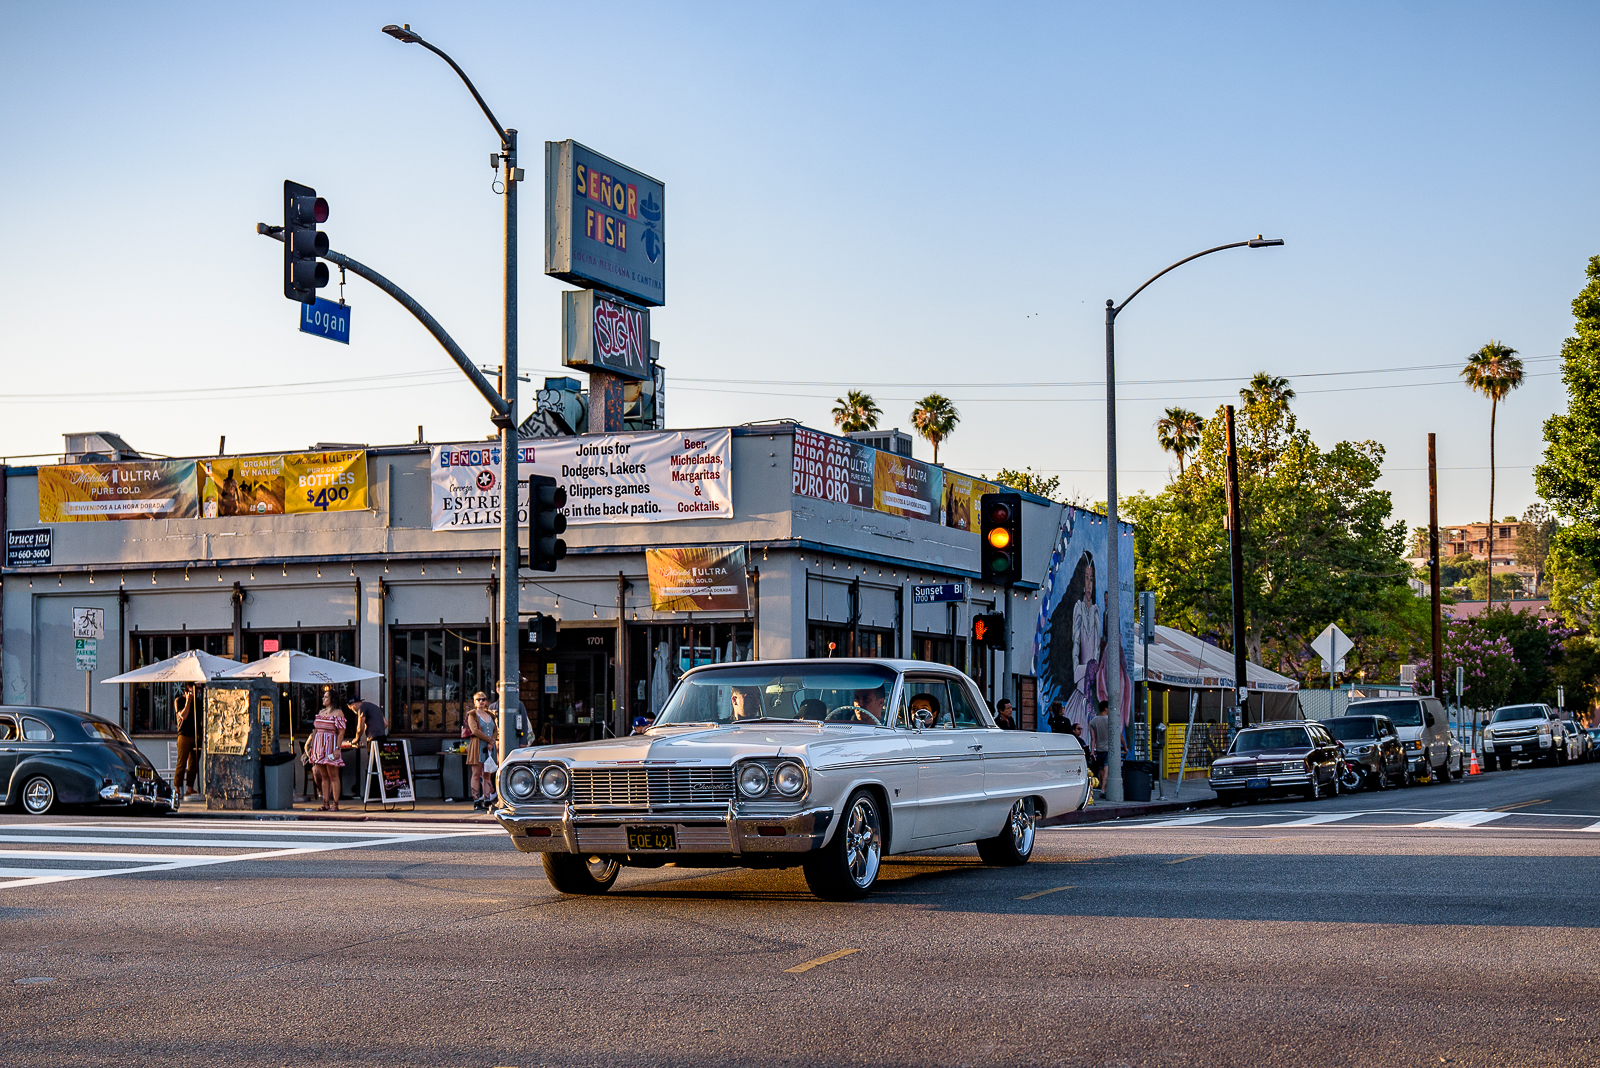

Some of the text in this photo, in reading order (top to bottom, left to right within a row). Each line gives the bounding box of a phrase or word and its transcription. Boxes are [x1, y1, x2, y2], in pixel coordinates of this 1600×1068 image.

[577, 164, 636, 216] SEÑOR
[588, 210, 626, 248] FISH
[573, 250, 596, 266] COCINA
[600, 260, 630, 278] MEXICANA
[637, 274, 662, 290] CANTINA
[306, 304, 344, 334] Logan
[595, 300, 644, 369] SIGN
[576, 442, 630, 456] Join us for
[684, 439, 707, 450] Beer,
[329, 454, 360, 462] ULTRA
[441, 450, 490, 466] SEÑOR
[671, 454, 722, 466] Micheladas,
[562, 462, 646, 479] Dodgers, Lakers
[850, 458, 872, 474] ULTRA
[69, 468, 161, 484] Michelob ULTRA
[299, 472, 355, 487] BOTTLES
[672, 470, 720, 483] Margaritas
[911, 468, 927, 482] ULTRA
[570, 484, 612, 499] Clippers
[615, 484, 650, 498] games
[694, 486, 701, 496] &
[792, 471, 849, 504] PURO ORO
[572, 504, 582, 516] in
[584, 503, 601, 516] the
[603, 502, 629, 515] back
[631, 501, 662, 516] patio.
[678, 501, 720, 513] Cocktails
[450, 509, 528, 525] JALISO
[9, 532, 50, 547] bruce jay
[18, 549, 50, 558] 660-3600
[698, 568, 727, 576] ULTRA
[915, 586, 943, 596] Sunset
[630, 834, 674, 847] EQE 491
